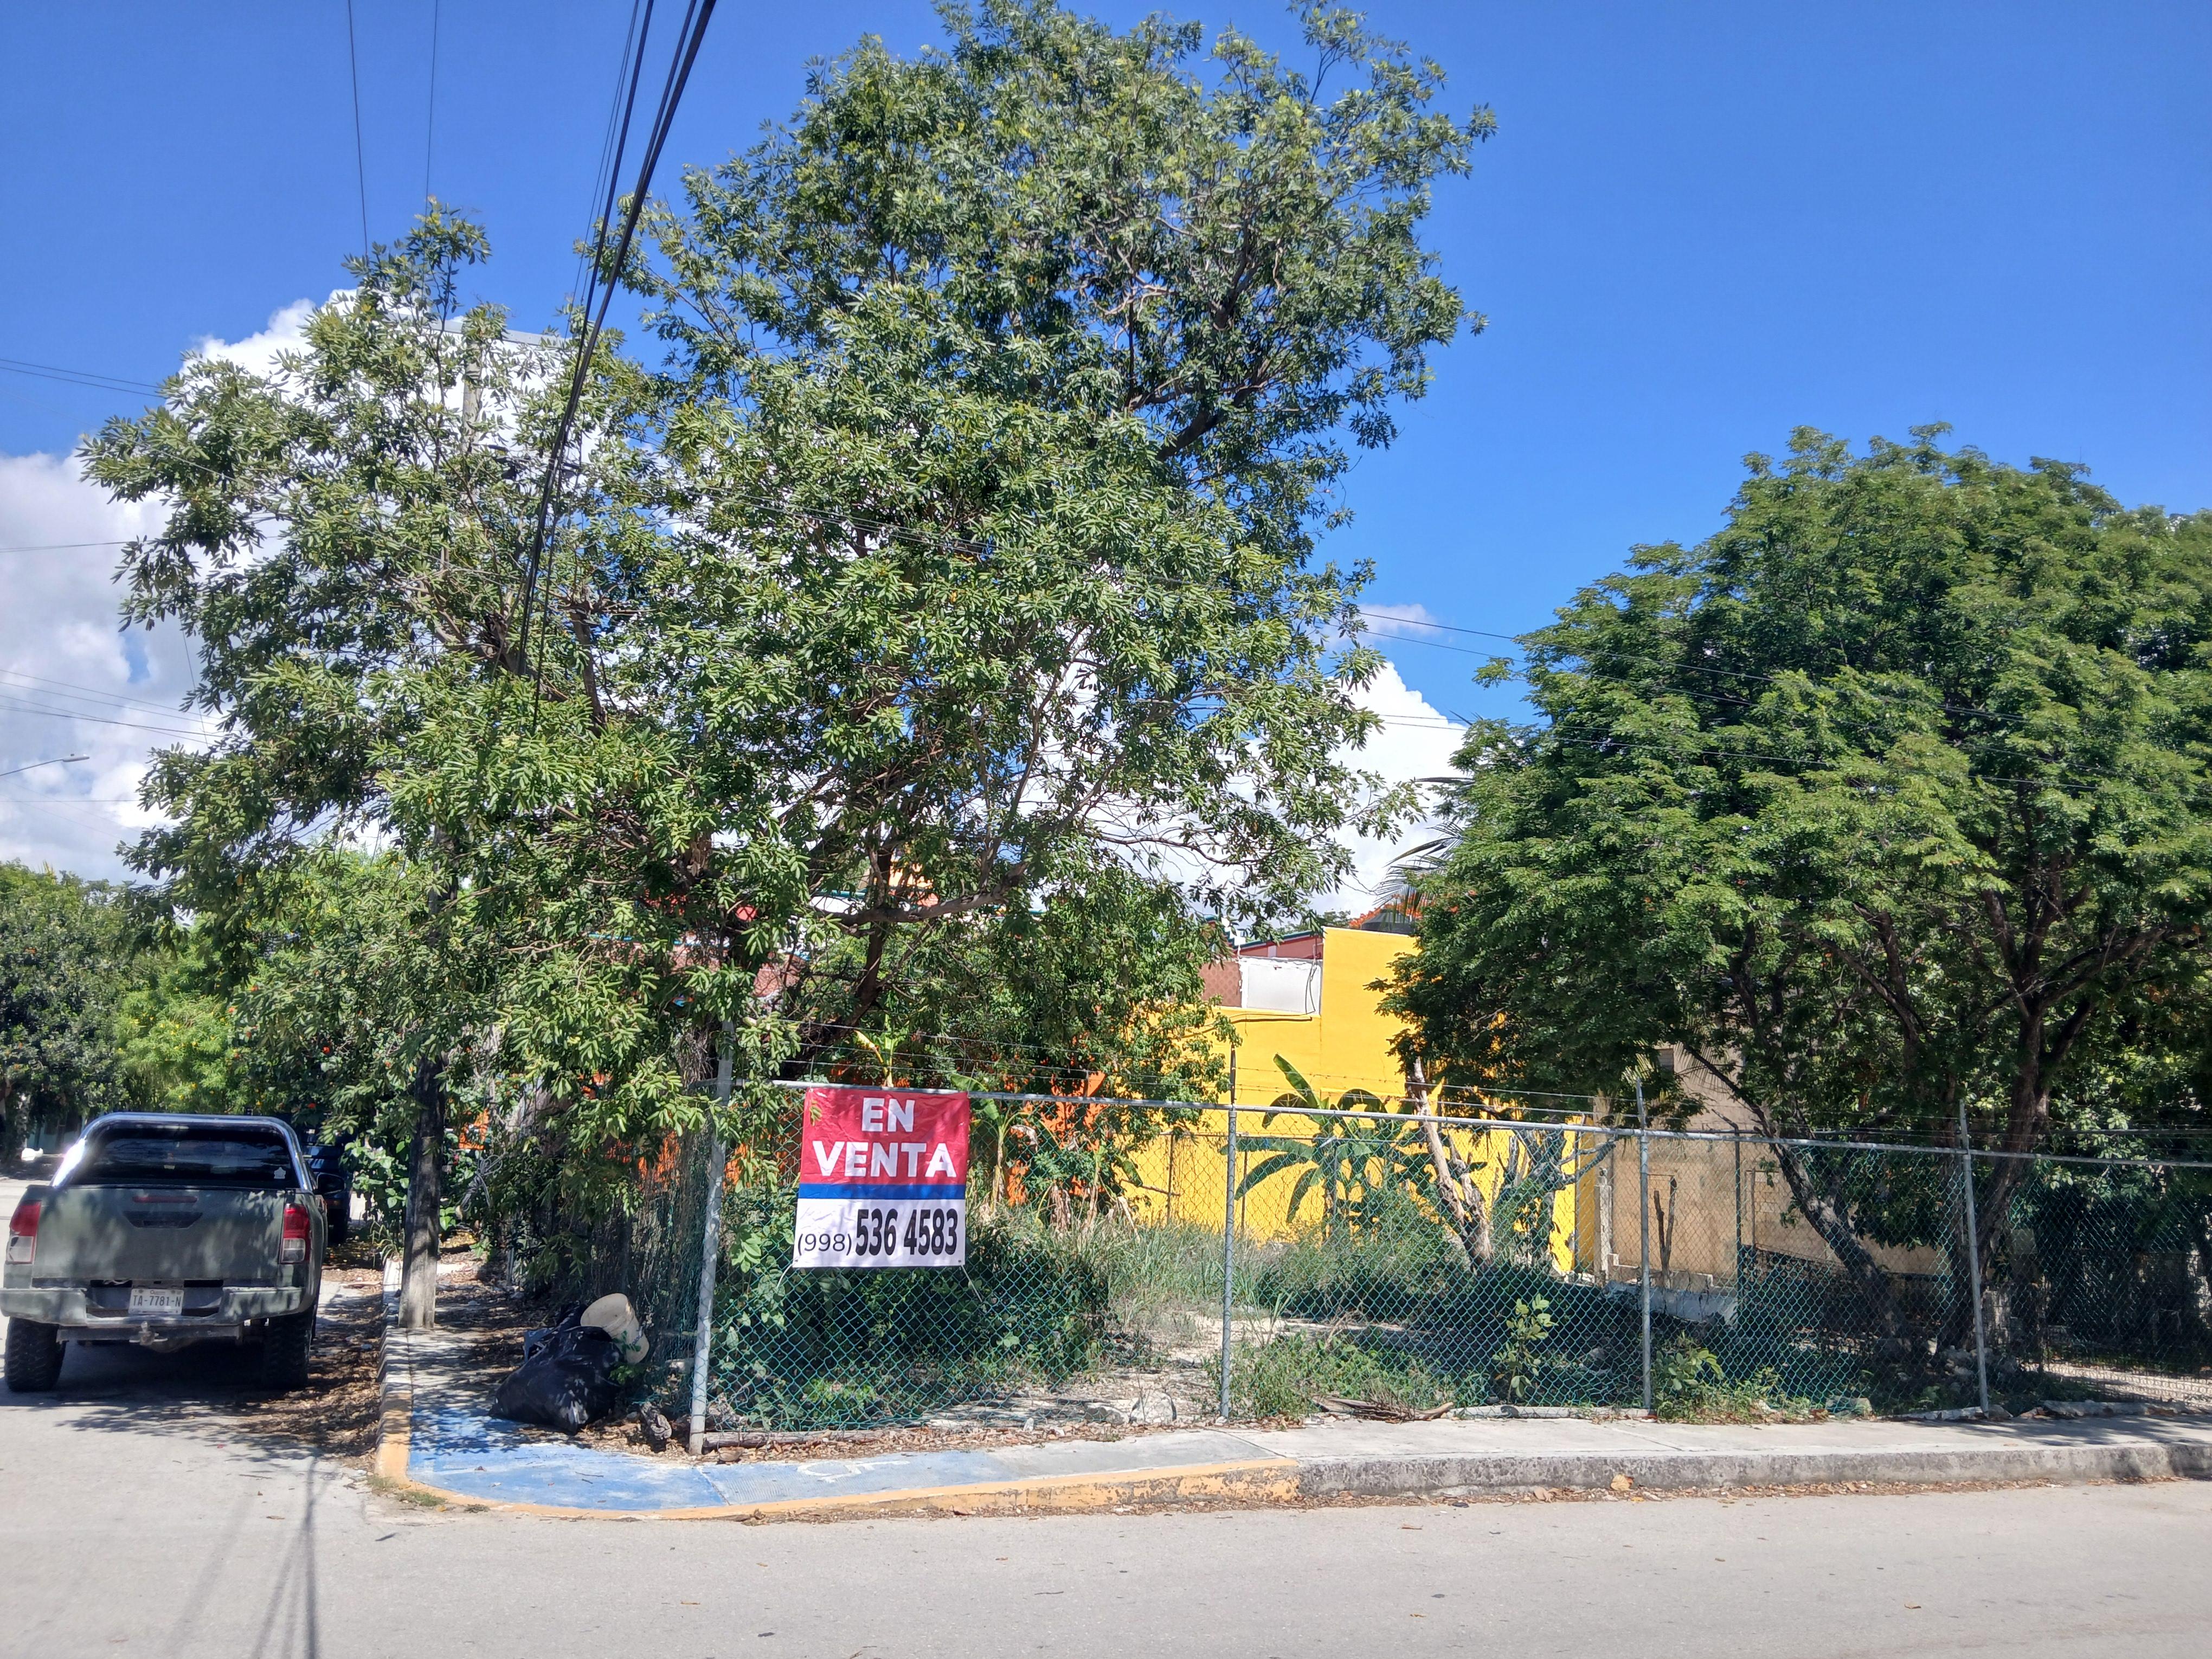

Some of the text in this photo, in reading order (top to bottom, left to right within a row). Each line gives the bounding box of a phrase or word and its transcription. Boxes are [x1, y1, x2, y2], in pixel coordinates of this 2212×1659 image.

[861, 1097, 916, 1133] EN
[812, 1141, 957, 1178] VENTA
[798, 1208, 958, 1256] (998) 536 4583
[133, 1295, 181, 1307] TA-7781-N
